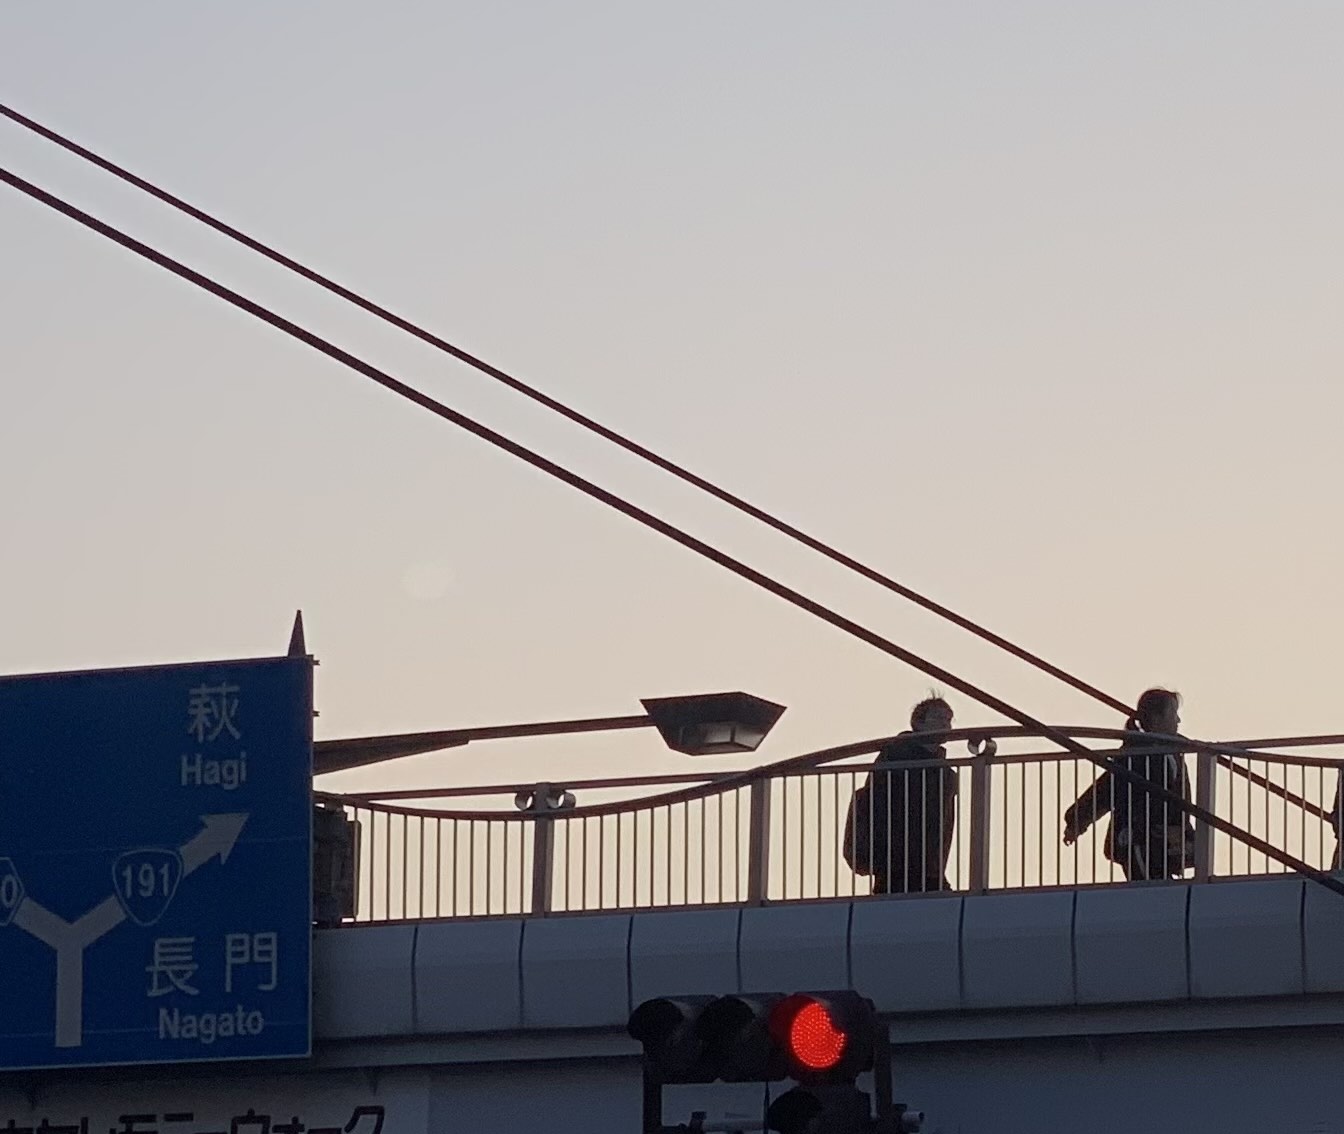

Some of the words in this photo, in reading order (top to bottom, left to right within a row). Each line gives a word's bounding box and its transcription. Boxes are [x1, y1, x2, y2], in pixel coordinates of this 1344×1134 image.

[187, 681, 241, 743] 萩
[181, 752, 248, 791] Hagi
[122, 863, 169, 898] 191
[145, 931, 278, 998] 長門
[158, 1004, 264, 1043] Nagato
